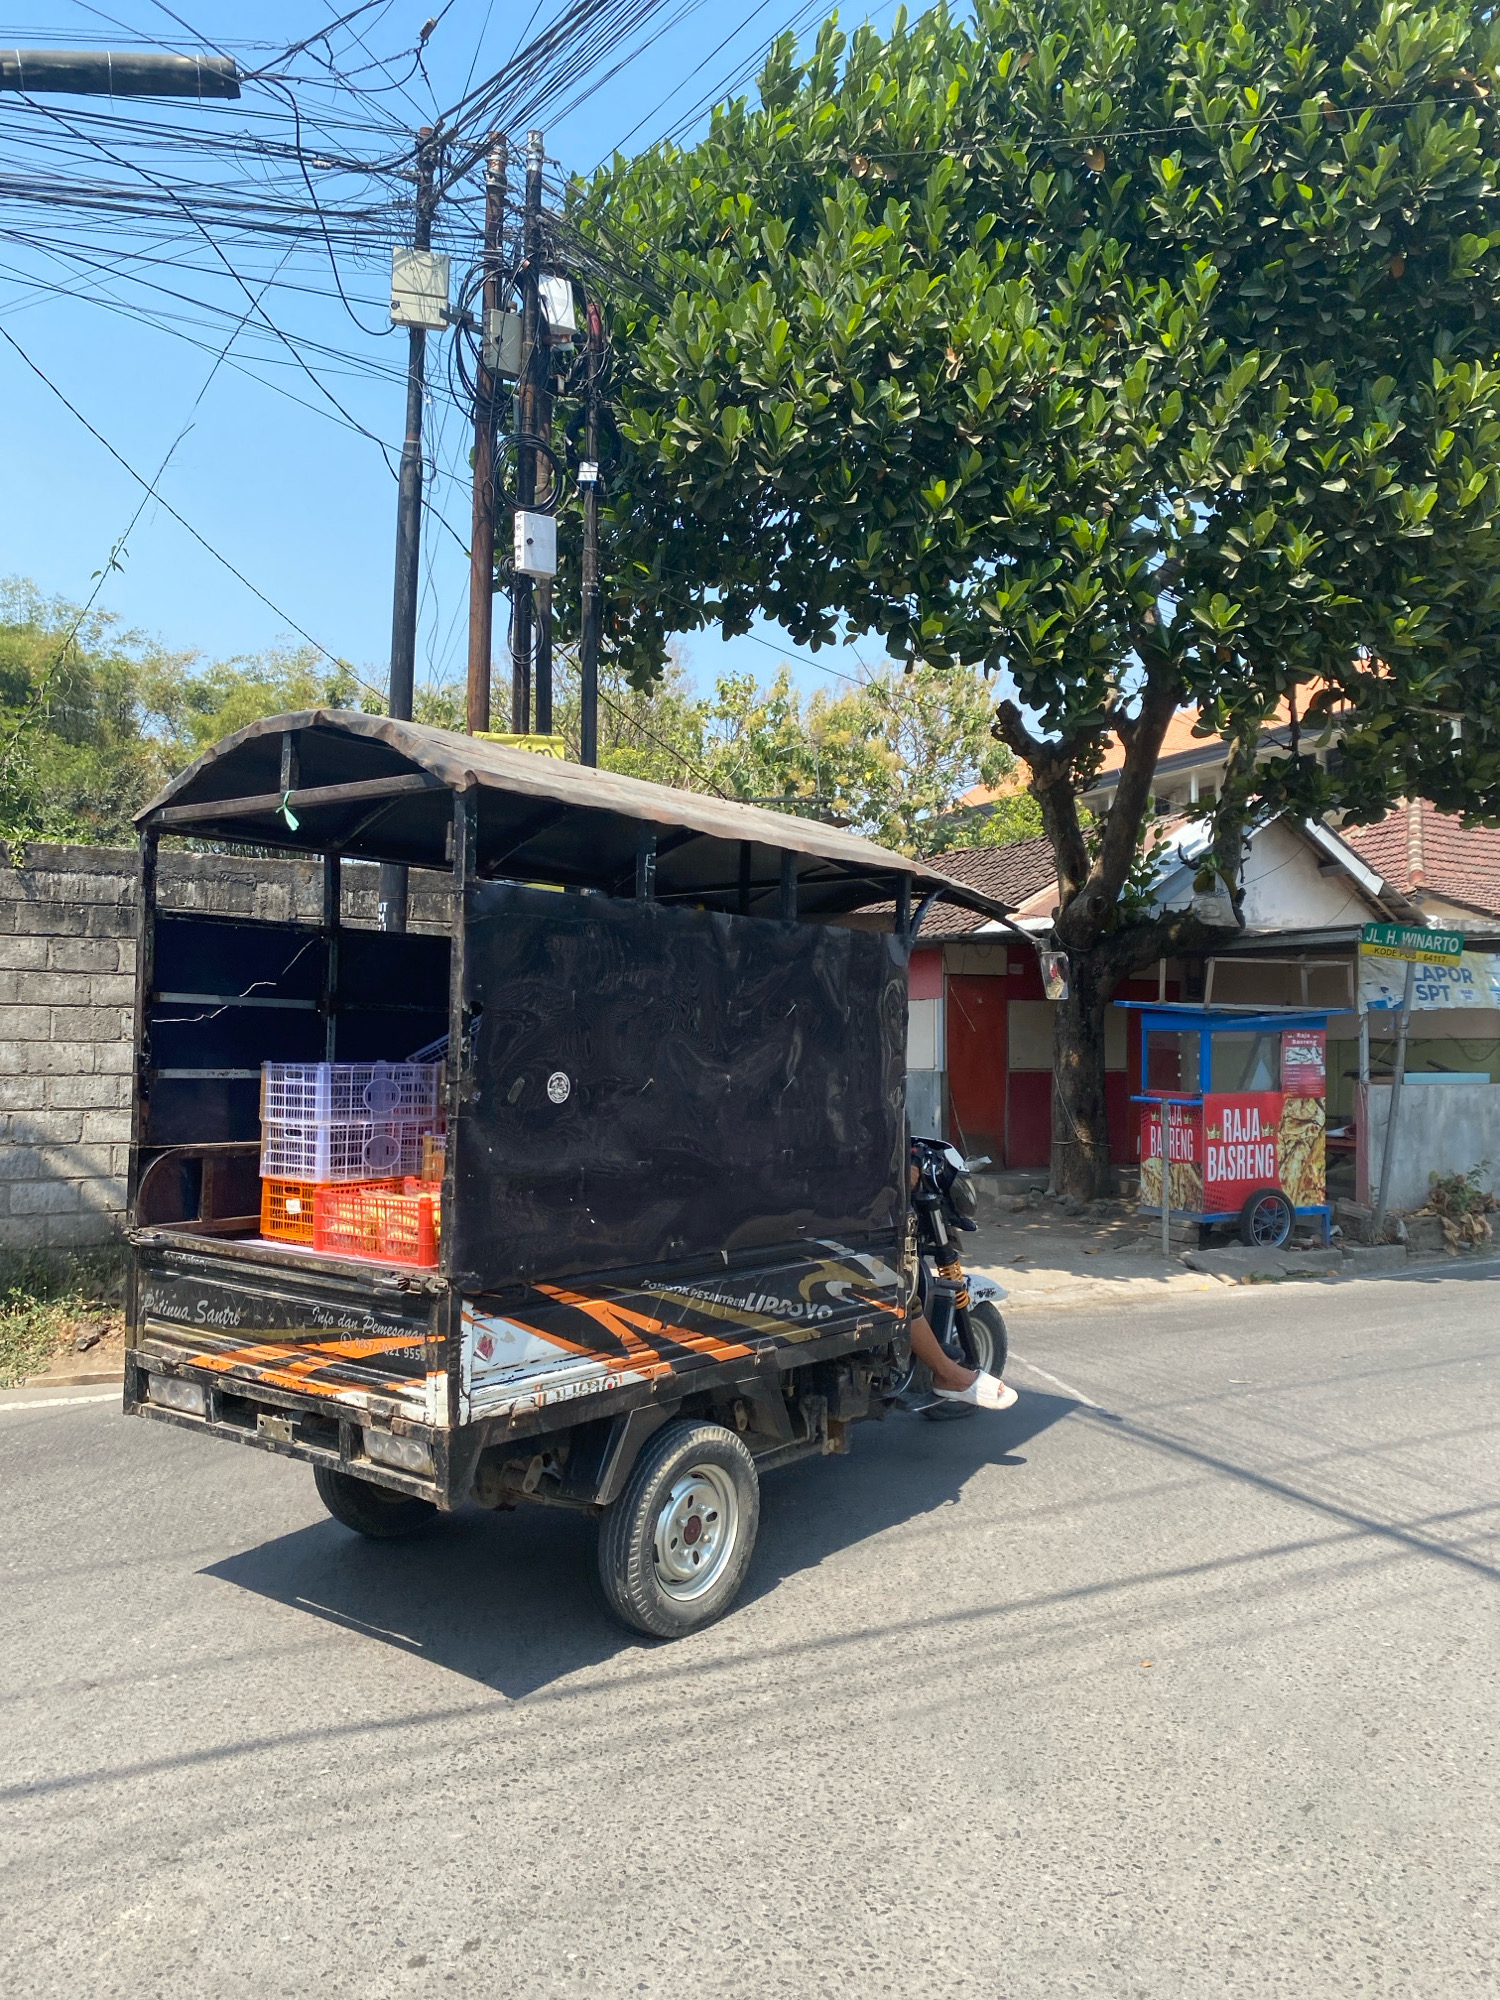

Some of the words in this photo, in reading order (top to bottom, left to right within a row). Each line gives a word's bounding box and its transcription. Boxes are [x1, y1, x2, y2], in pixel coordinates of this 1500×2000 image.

[1366, 928, 1382, 943] JL.
[1386, 930, 1397, 945] H.
[1402, 932, 1459, 953] WINARTO
[1374, 947, 1397, 957] KODE
[1424, 953, 1447, 964] 64117
[1416, 984, 1450, 1001] SPT
[1161, 1104, 1183, 1126] AJA
[1223, 1108, 1260, 1143] RAJA
[1150, 1125, 1193, 1161] BARENG
[1207, 1143, 1274, 1182] BASRENG
[690, 1288, 745, 1308] PESANTREN
[312, 1306, 333, 1329] Info
[337, 1313, 358, 1330] dan
